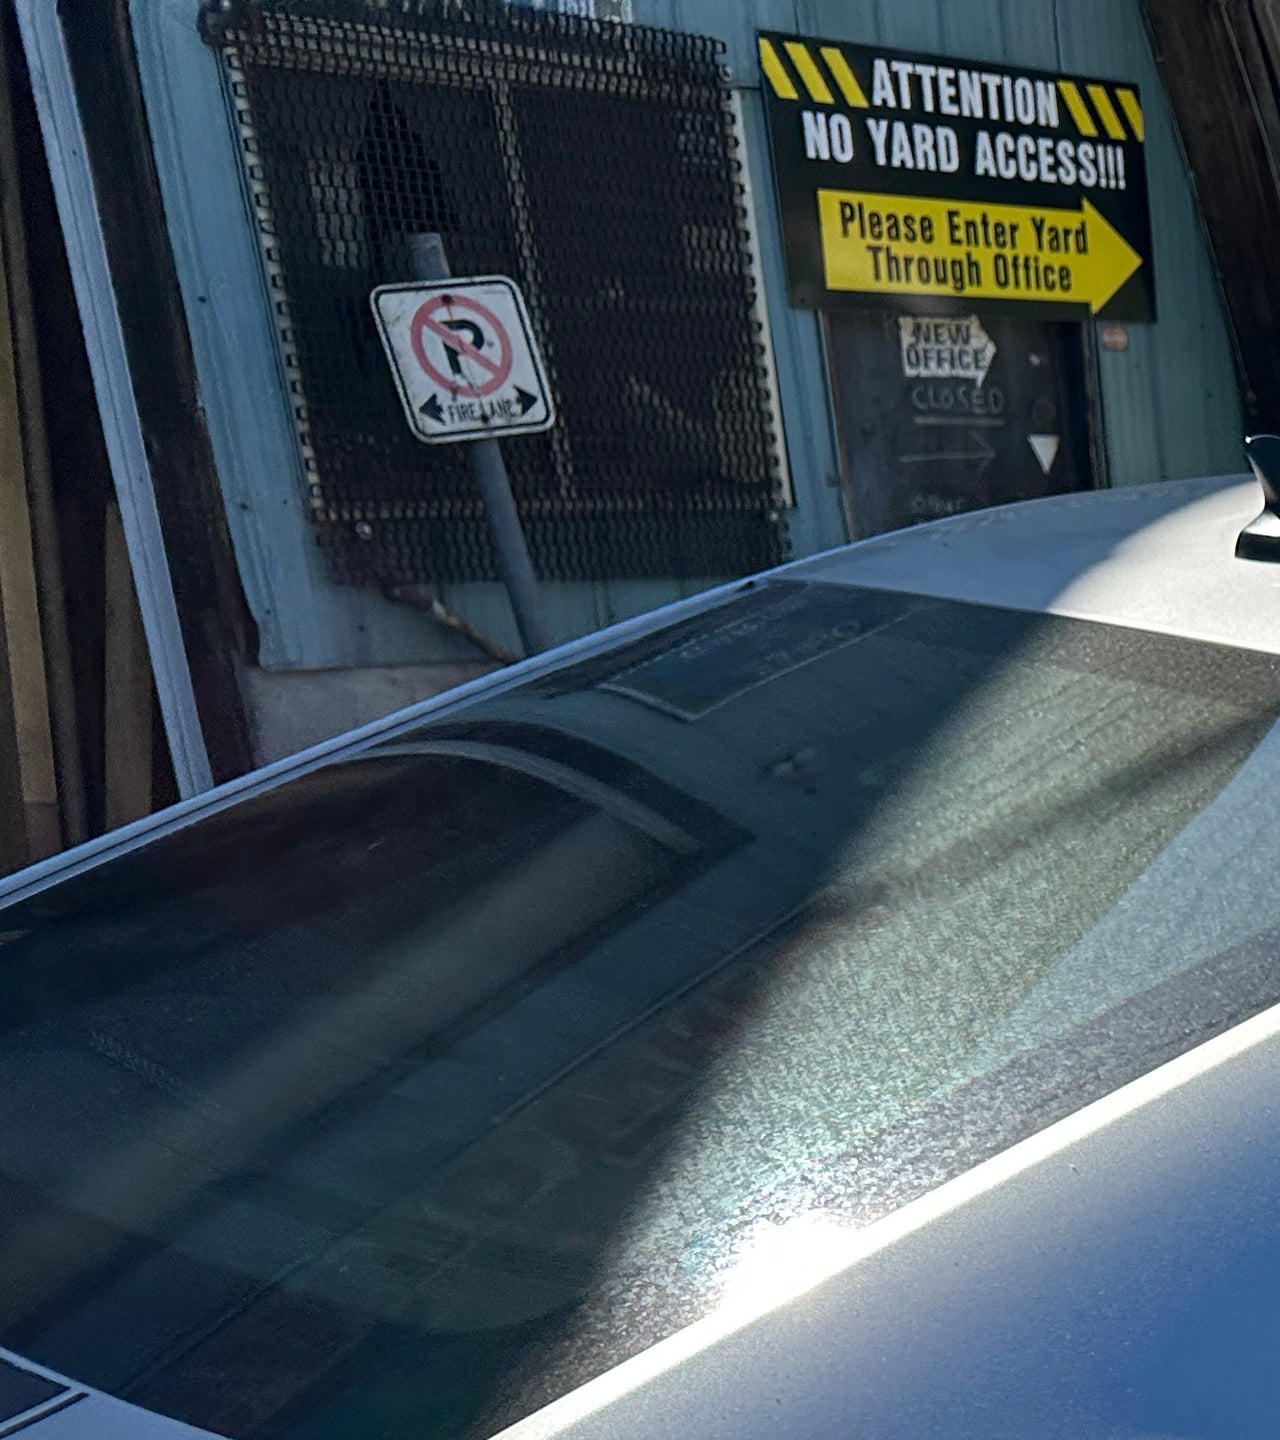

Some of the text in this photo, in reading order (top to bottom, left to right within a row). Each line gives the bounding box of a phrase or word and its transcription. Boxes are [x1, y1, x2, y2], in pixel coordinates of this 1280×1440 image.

[872, 58, 1060, 128] ATTENTION
[802, 110, 1127, 190] NO YARD ACCESS!!!
[839, 201, 1089, 255] Please Enter Yard
[866, 246, 1072, 292] Through Office
[913, 321, 971, 346] NEW
[906, 344, 989, 371] OFFICE
[448, 403, 478, 424] FIRE
